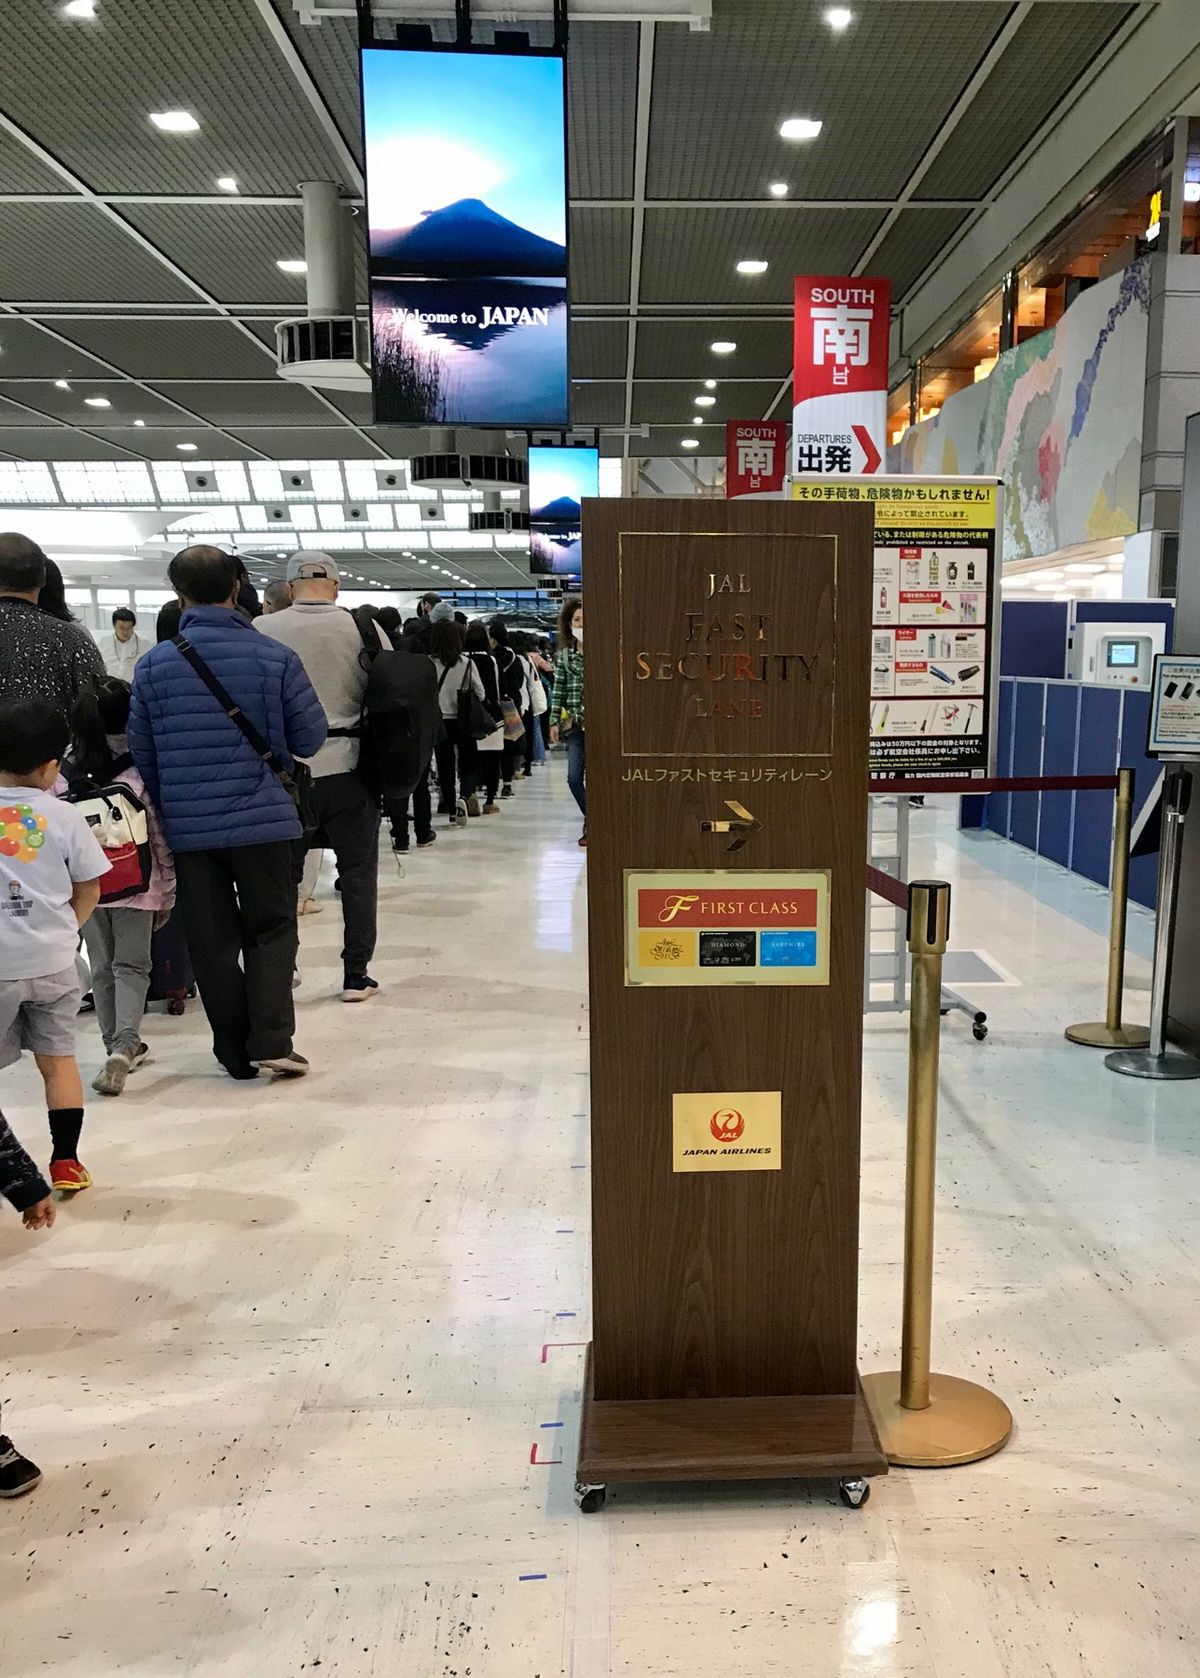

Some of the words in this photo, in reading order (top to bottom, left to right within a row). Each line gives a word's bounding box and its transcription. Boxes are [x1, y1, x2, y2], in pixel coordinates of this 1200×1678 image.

[810, 287, 875, 304] SOUTH
[391, 307, 458, 325] Welcome
[461, 312, 477, 325] to
[478, 306, 549, 329] JAPAN
[810, 304, 874, 366] 南
[832, 366, 850, 385] 남
[736, 427, 777, 438] SOUTH
[797, 434, 852, 444] DEPARTURES
[736, 437, 776, 476] 南
[797, 444, 851, 473] 出発
[750, 476, 761, 488] 남
[708, 573, 751, 599] JAL
[685, 612, 773, 641] FAST
[635, 651, 820, 681] SECURITY
[696, 698, 763, 718] LANE
[621, 767, 833, 783] JALファストセキュリティレーン
[701, 902, 744, 915] FIRST
[748, 901, 799, 915] CLASS
[719, 1147, 772, 1155] AIRLINES
